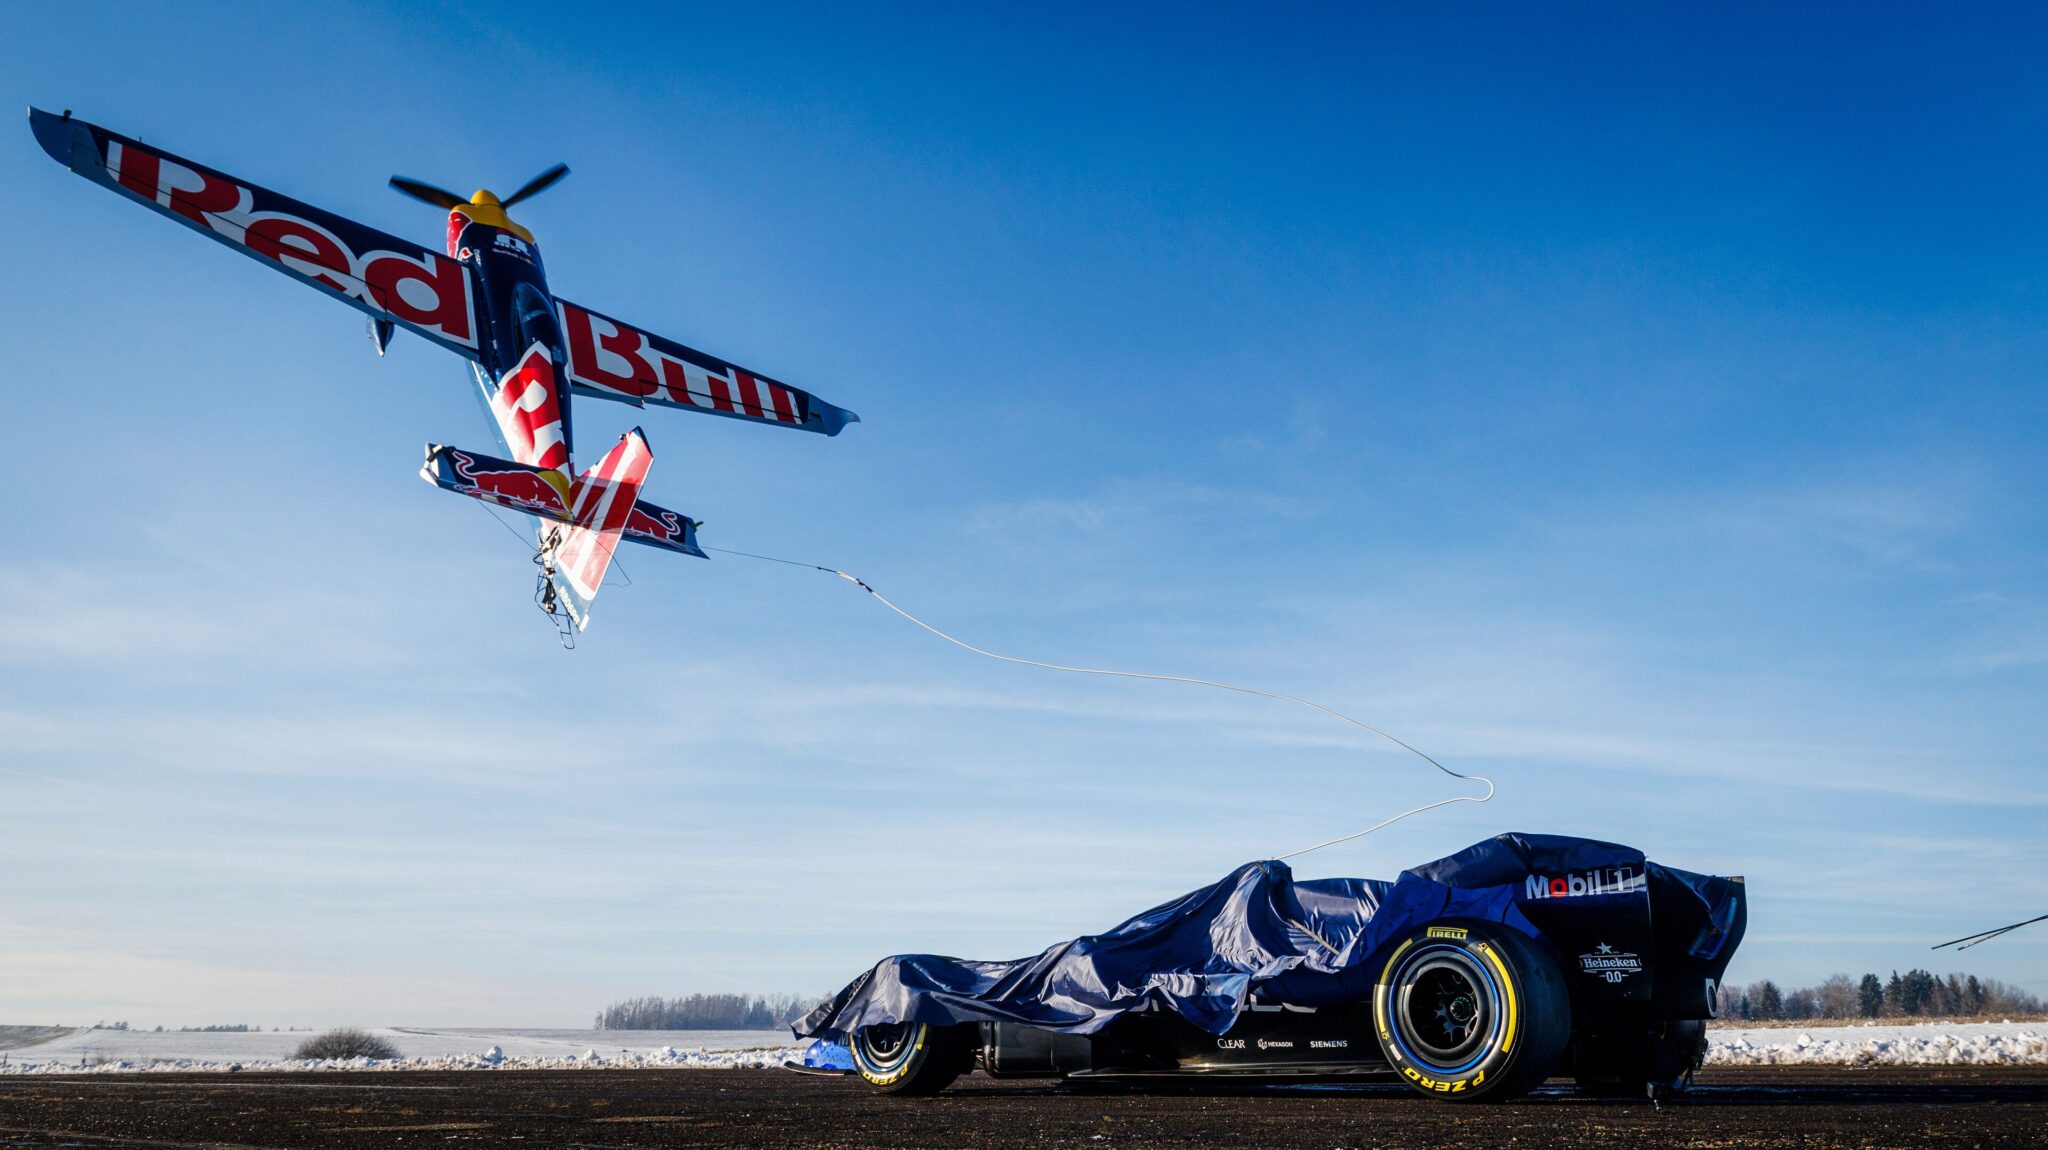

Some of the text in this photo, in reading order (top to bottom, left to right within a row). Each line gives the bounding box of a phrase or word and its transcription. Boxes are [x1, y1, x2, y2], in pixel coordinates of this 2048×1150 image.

[107, 140, 478, 348] Red
[558, 302, 803, 424] Bull
[1525, 869, 1602, 900] Mobil
[1427, 926, 1469, 940] PIRELLI
[1583, 957, 1638, 968] Heineken
[1605, 971, 1622, 983] 0.0
[1217, 1038, 1246, 1049] CLEAR
[1310, 1040, 1348, 1048] SIEMENS
[862, 1063, 909, 1086] P ZERO
[1403, 1067, 1485, 1092] P ZERO
